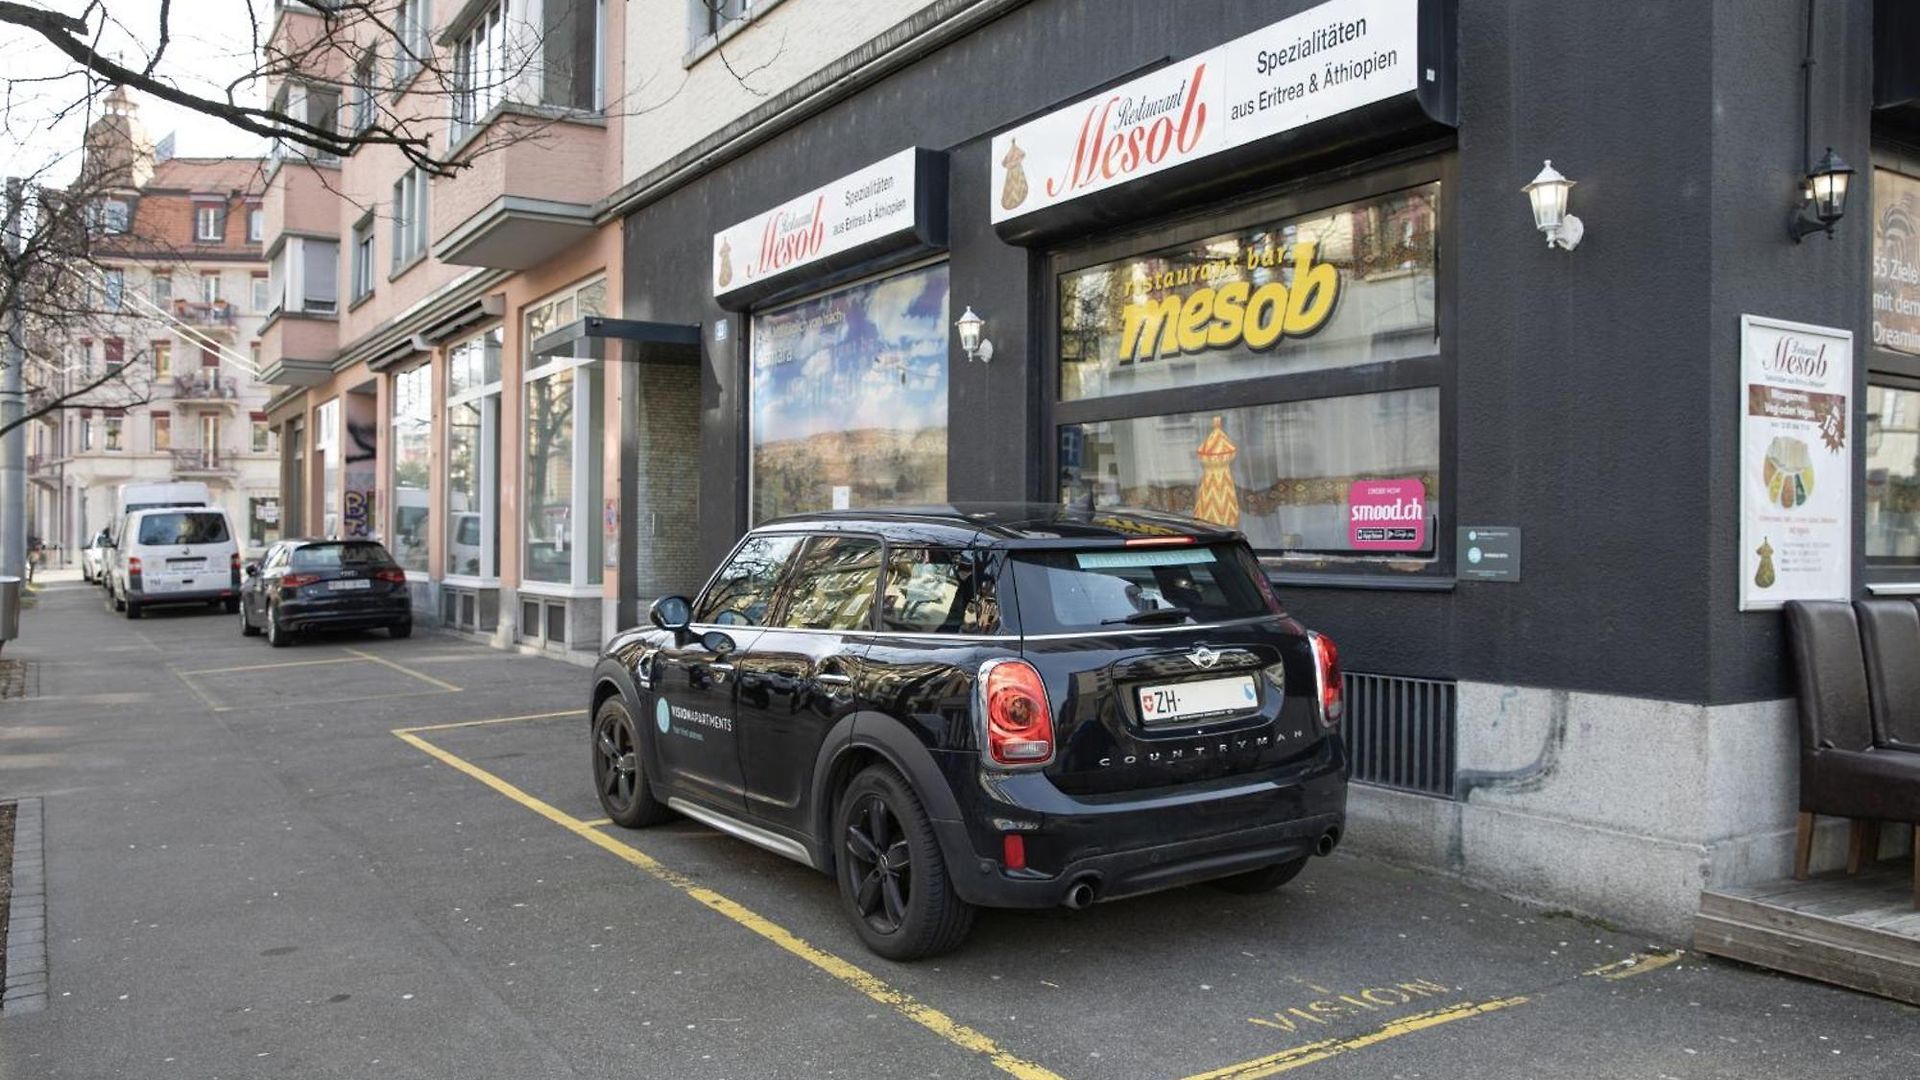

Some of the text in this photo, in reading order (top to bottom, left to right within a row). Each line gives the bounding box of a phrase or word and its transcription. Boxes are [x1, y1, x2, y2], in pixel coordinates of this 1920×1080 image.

[1256, 17, 1367, 76] Spezialitäten
[1113, 79, 1186, 131] Restaurant
[1231, 49, 1398, 121] aus Eritrea & Äthiopien
[1046, 63, 1207, 199] Mesob
[845, 175, 894, 209] Spezialitäten
[746, 195, 825, 279] Mesob
[833, 222, 845, 236] aus
[845, 213, 866, 232] Eritrea
[1247, 246, 1288, 271] bar
[1119, 240, 1342, 366] mesob
[1873, 290, 1920, 317] mit dem
[1762, 336, 1828, 378] Mesob
[1351, 497, 1422, 521] smood.ch
[670, 705, 732, 732] VISIONAPARTMENTS
[1099, 730, 1303, 767] COUNTRYMAN
[1247, 977, 1450, 1032] VISION
